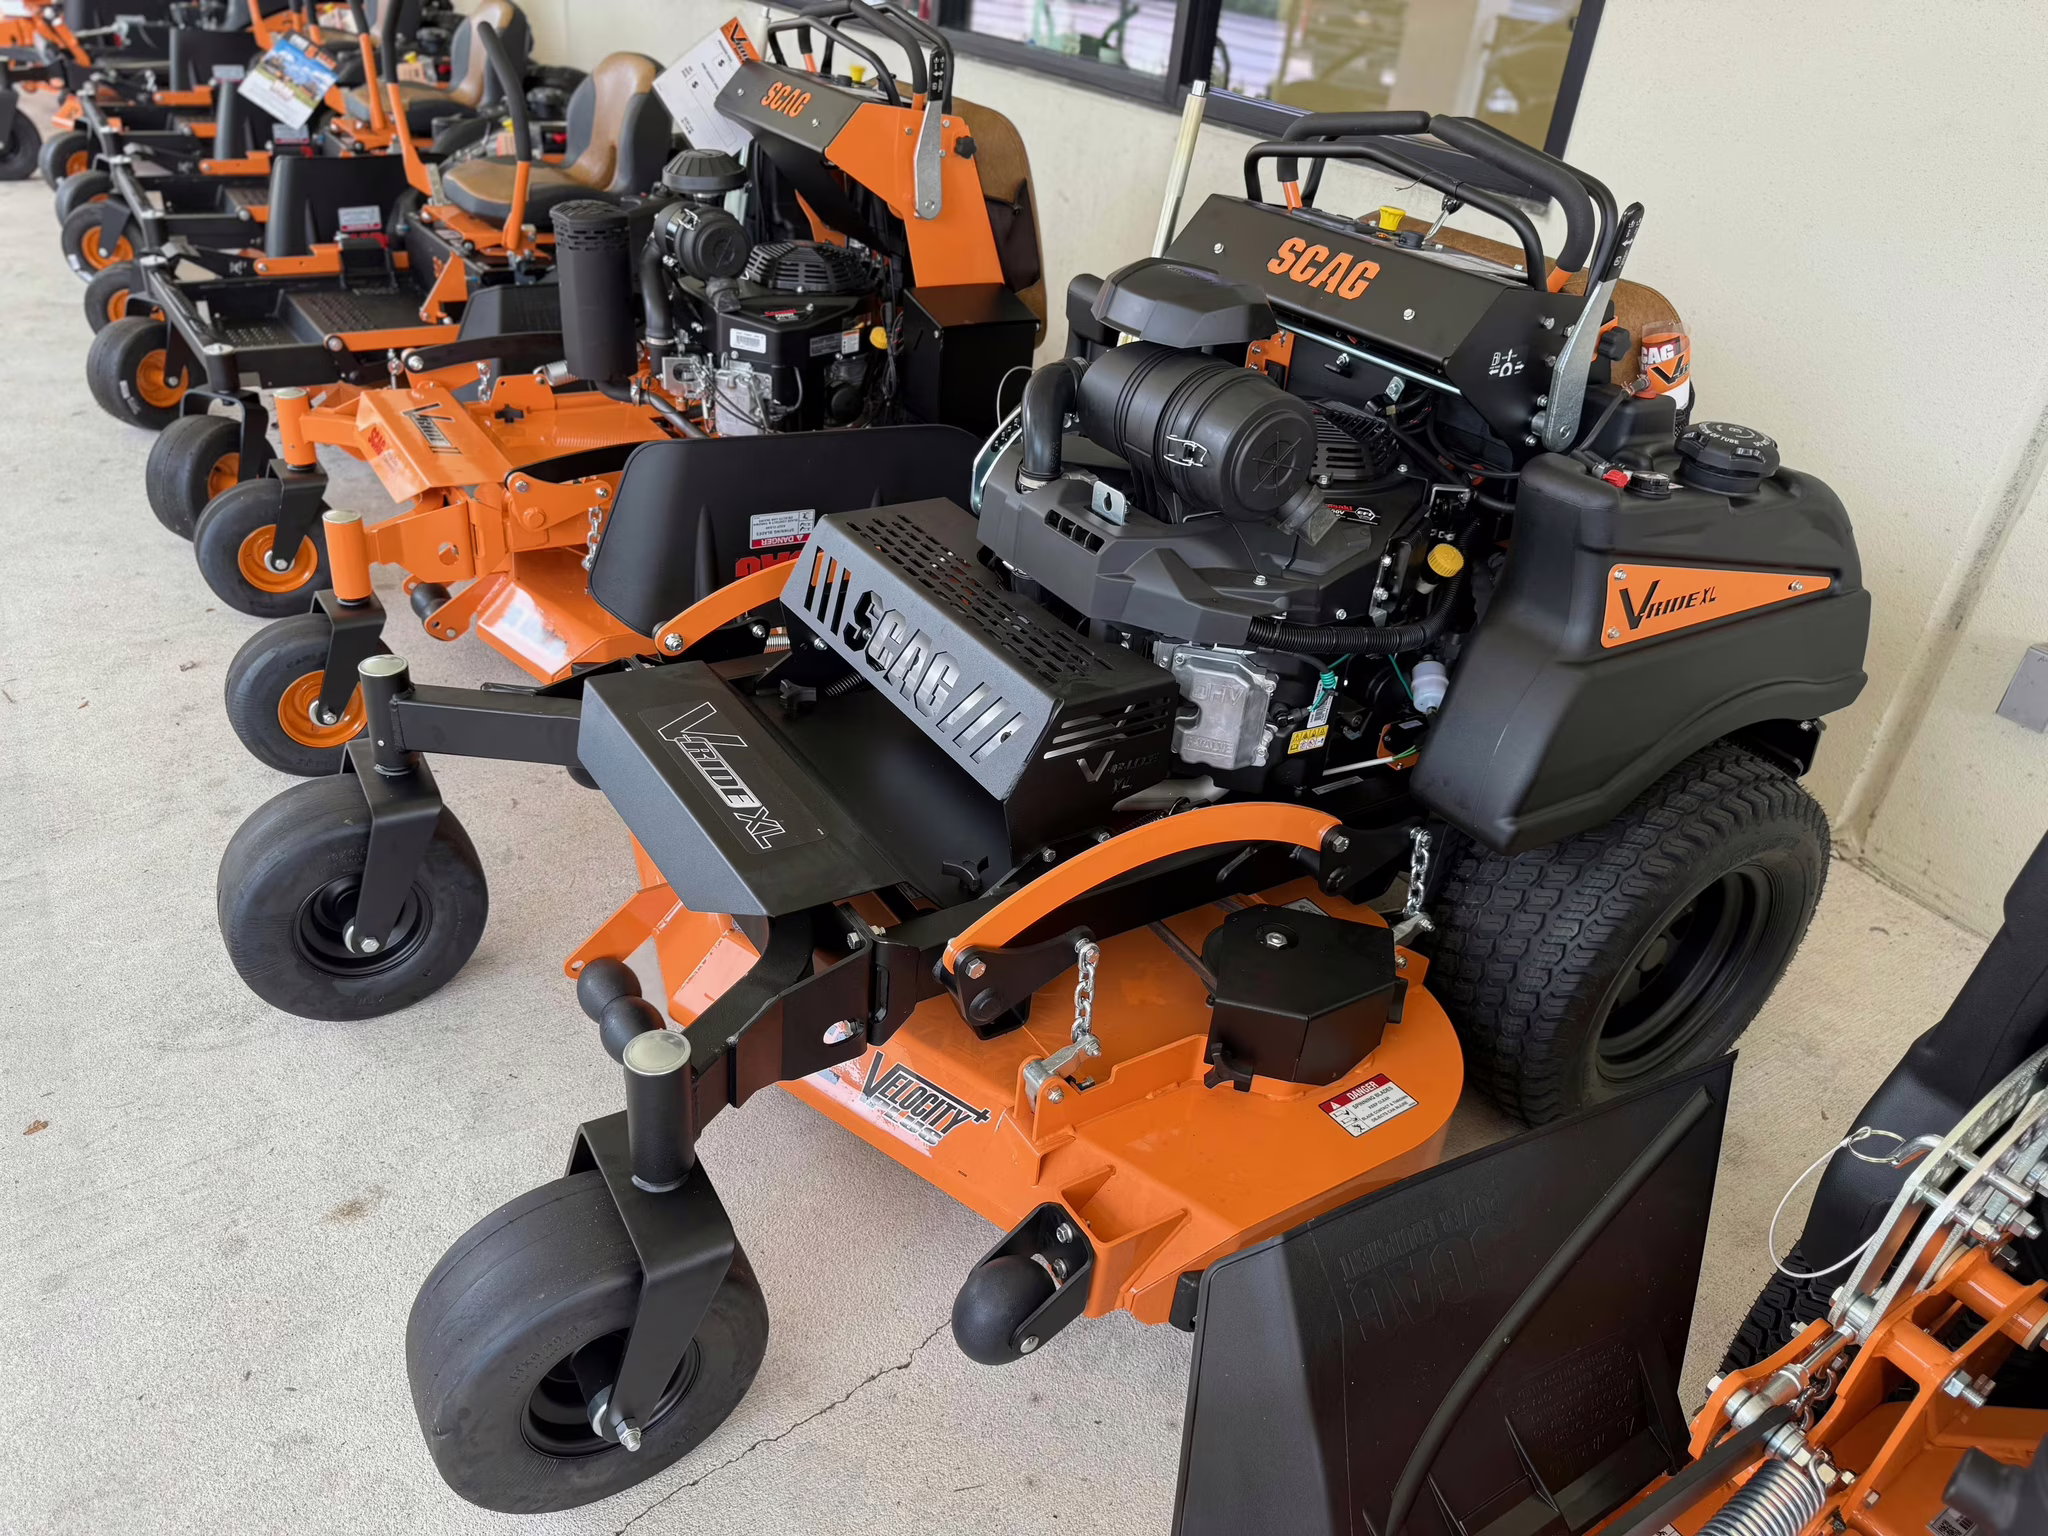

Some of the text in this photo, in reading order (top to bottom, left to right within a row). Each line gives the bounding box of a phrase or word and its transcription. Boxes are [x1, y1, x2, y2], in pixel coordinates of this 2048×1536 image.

[761, 81, 811, 117] SCAG
[1267, 237, 1380, 300] SCAG
[761, 536, 794, 546] DANGER
[843, 589, 960, 718] SCAG
[1191, 682, 1244, 706] OHV
[733, 806, 786, 849] XL
[1346, 1080, 1379, 1101] DANGER
[1351, 1086, 1394, 1110] SPINNING BLADES
